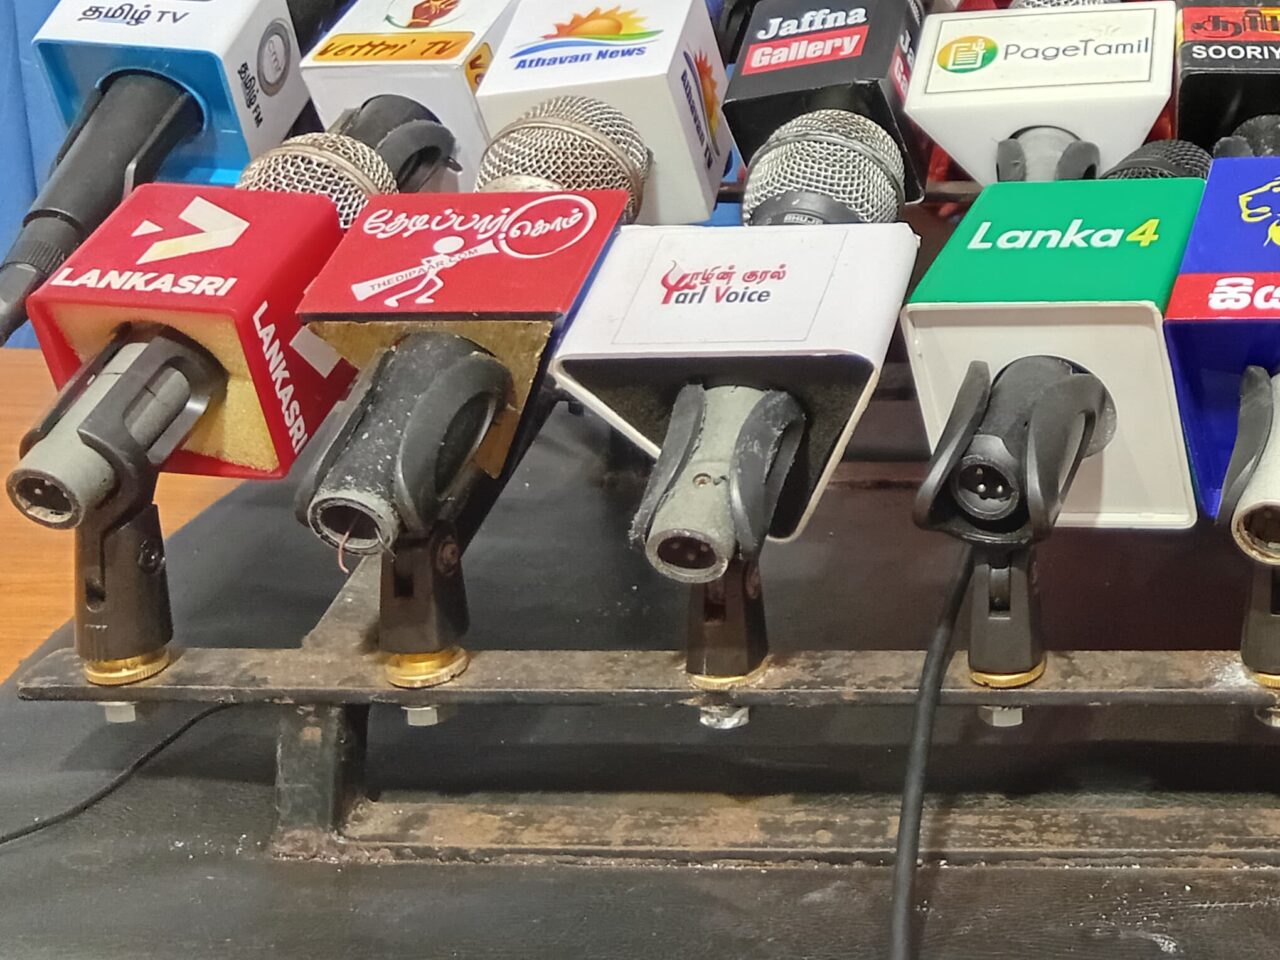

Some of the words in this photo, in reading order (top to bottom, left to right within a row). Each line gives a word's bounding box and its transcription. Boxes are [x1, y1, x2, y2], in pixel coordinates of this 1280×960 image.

[77, 3, 151, 26] தமிழ்
[156, 10, 190, 23] TV
[757, 6, 868, 40] Jaffna
[420, 39, 460, 56] TV
[514, 50, 593, 70] Athavan
[596, 45, 648, 64] News
[751, 33, 861, 68] Gallery
[1004, 38, 1149, 61] PageTamil
[252, 104, 264, 128] FM
[51, 267, 237, 297] LANKASRI
[369, 248, 479, 292] THEDIPAAR.COM
[742, 264, 787, 285] குரல்
[715, 286, 771, 304] Voice
[251, 301, 312, 455] LANKASRI
